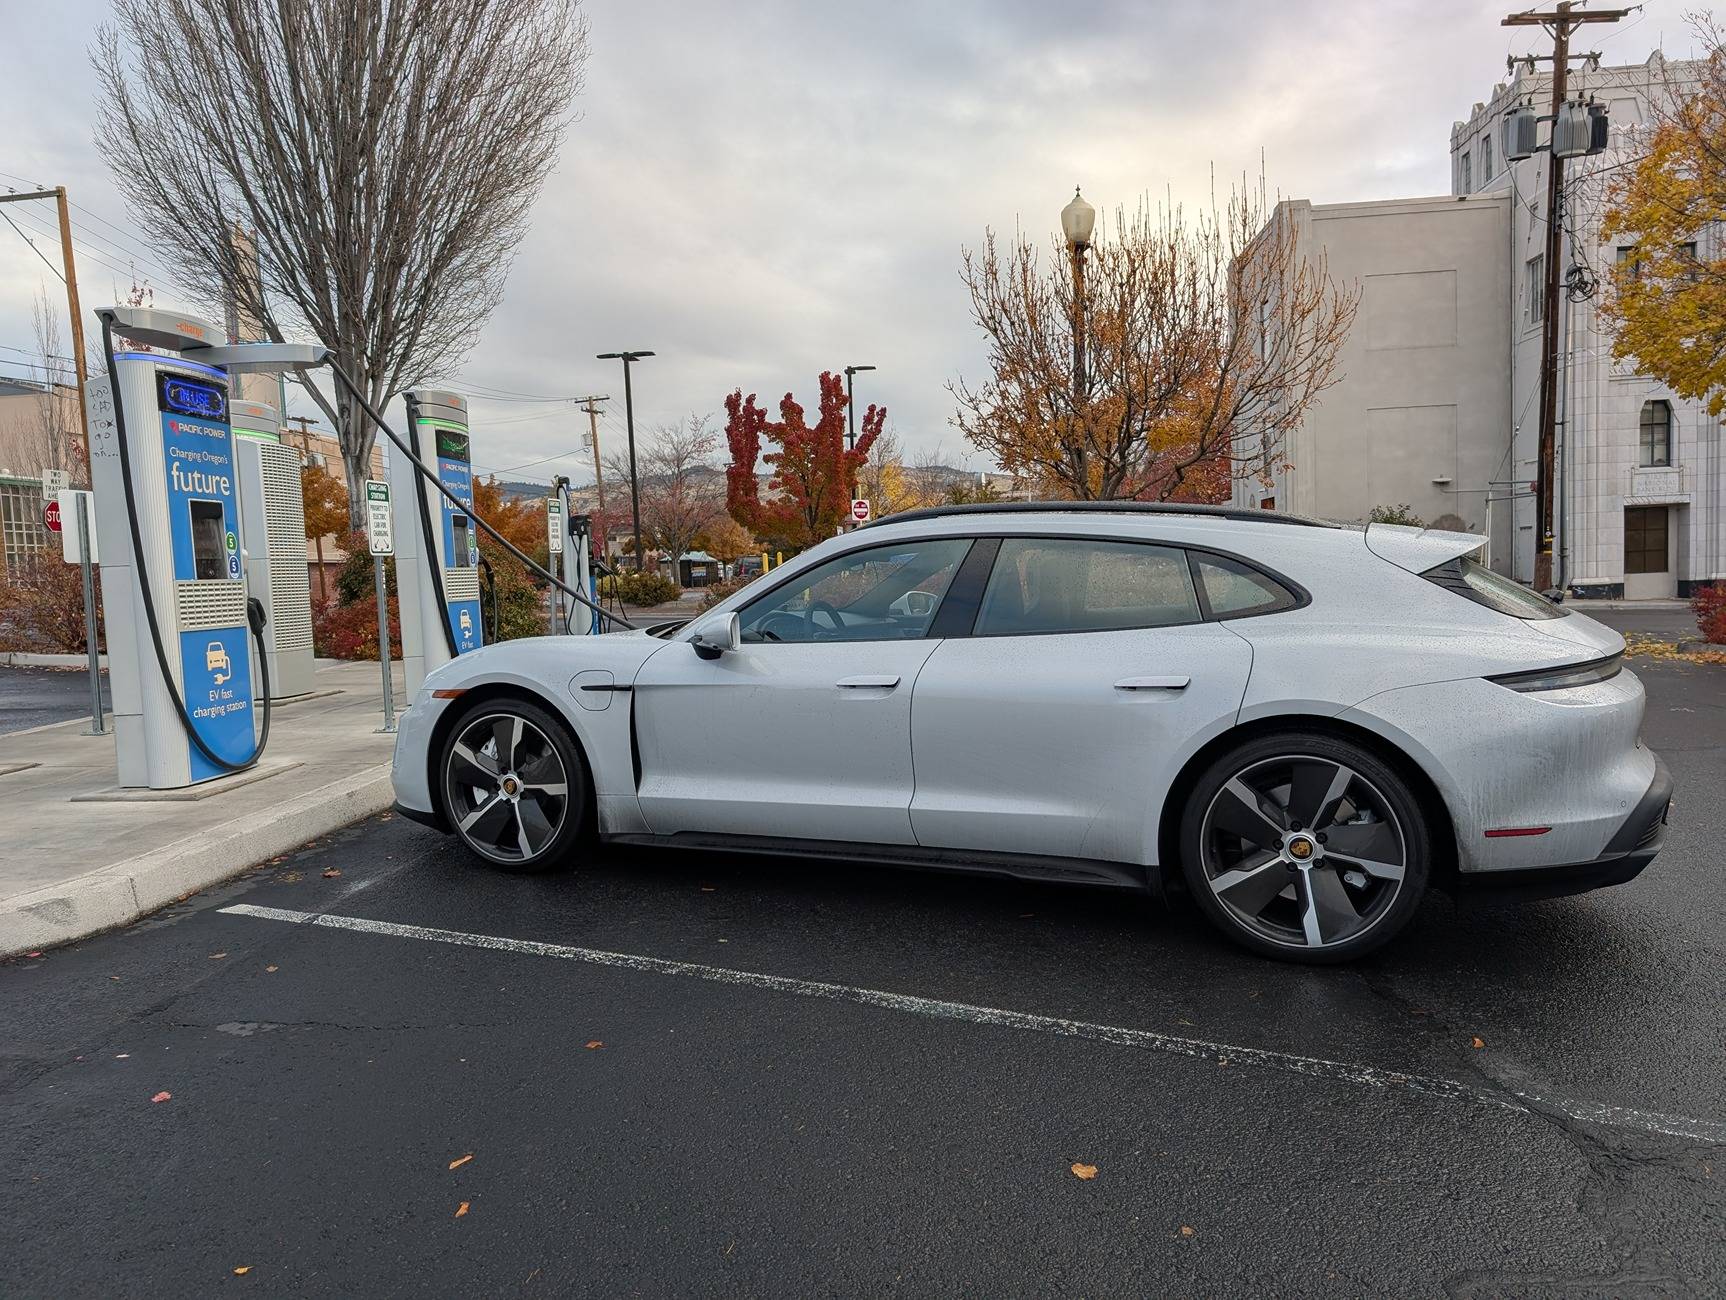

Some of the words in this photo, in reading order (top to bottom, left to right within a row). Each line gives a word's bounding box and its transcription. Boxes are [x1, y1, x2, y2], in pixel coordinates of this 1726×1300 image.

[191, 391, 209, 405] USE
[178, 423, 203, 435] PACIFIC
[203, 427, 226, 439] POWER
[170, 446, 202, 463] Charging
[202, 451, 228, 465] Oregon's
[171, 461, 230, 496] future
[46, 510, 61, 523] STO
[209, 689, 220, 701] EV
[221, 689, 233, 699] fast
[193, 705, 226, 719] charging
[226, 700, 247, 712] station
